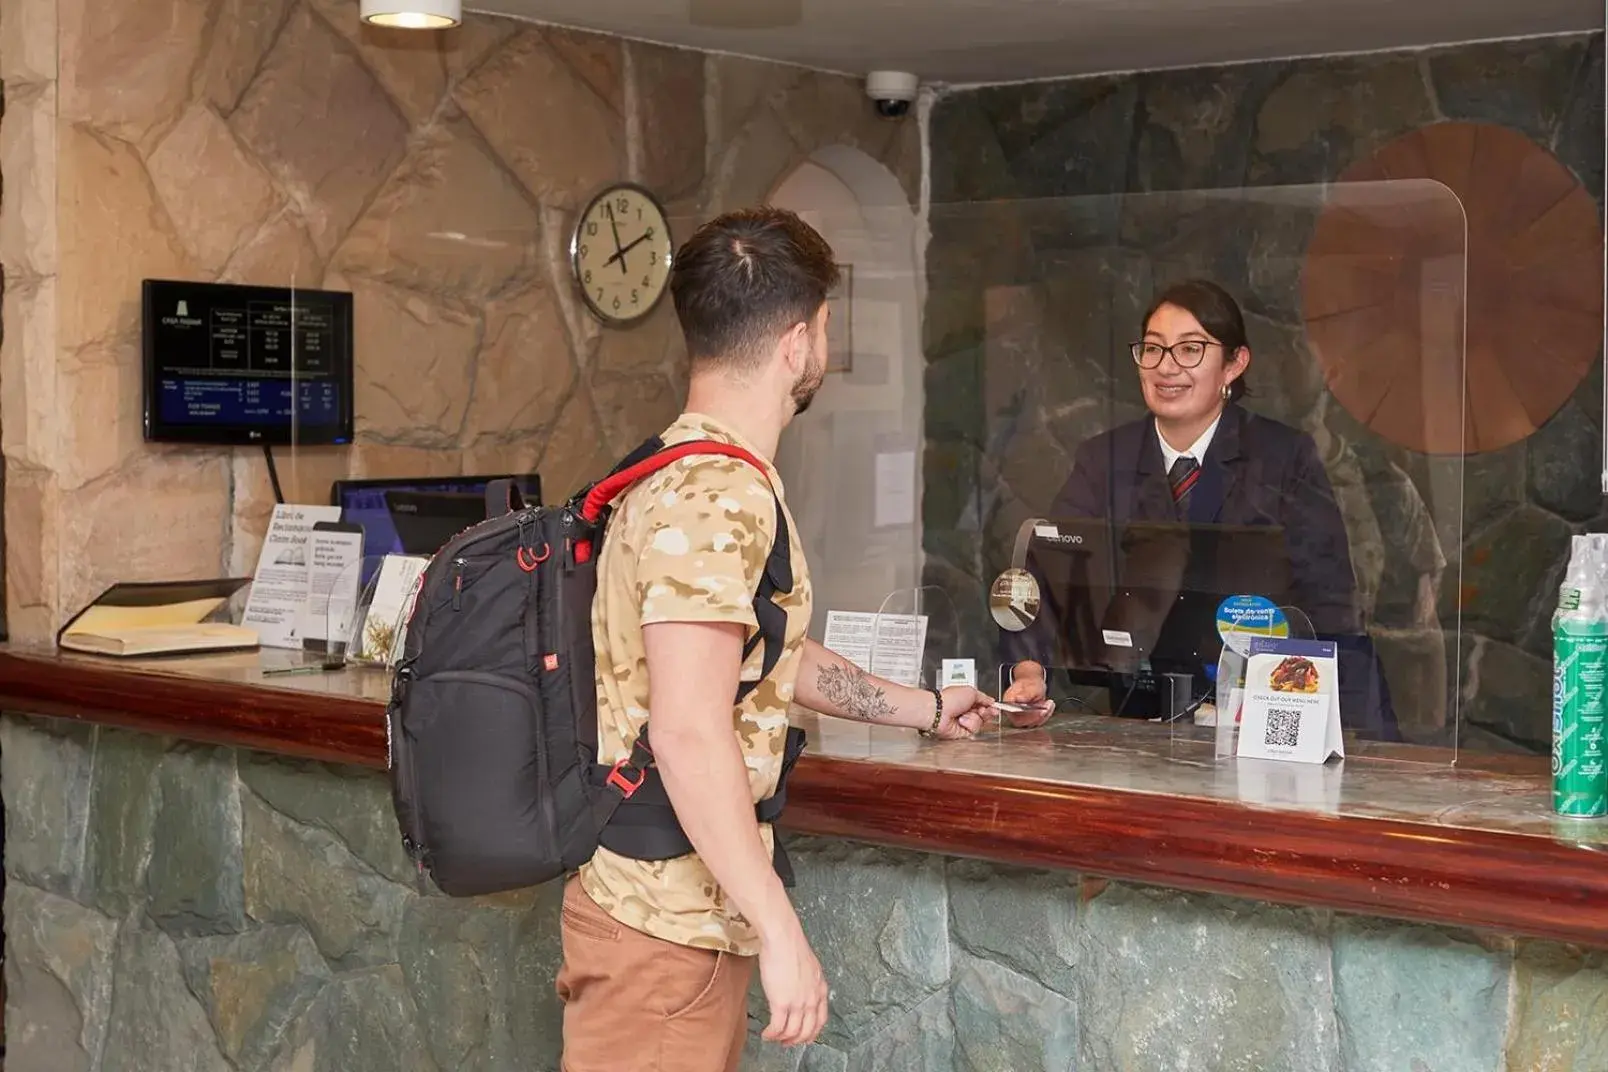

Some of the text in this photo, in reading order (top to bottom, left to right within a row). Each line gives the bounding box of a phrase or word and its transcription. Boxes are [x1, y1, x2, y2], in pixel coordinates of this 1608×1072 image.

[616, 198, 629, 214] 12
[637, 208, 642, 221] 1
[586, 222, 598, 236] 10
[646, 226, 654, 241] 2
[580, 244, 589, 259] 9
[650, 251, 656, 266] 3
[584, 269, 592, 284] 8
[641, 275, 650, 287] 4
[596, 287, 604, 301] 7
[631, 289, 638, 303] 5
[612, 296, 621, 310] 6
